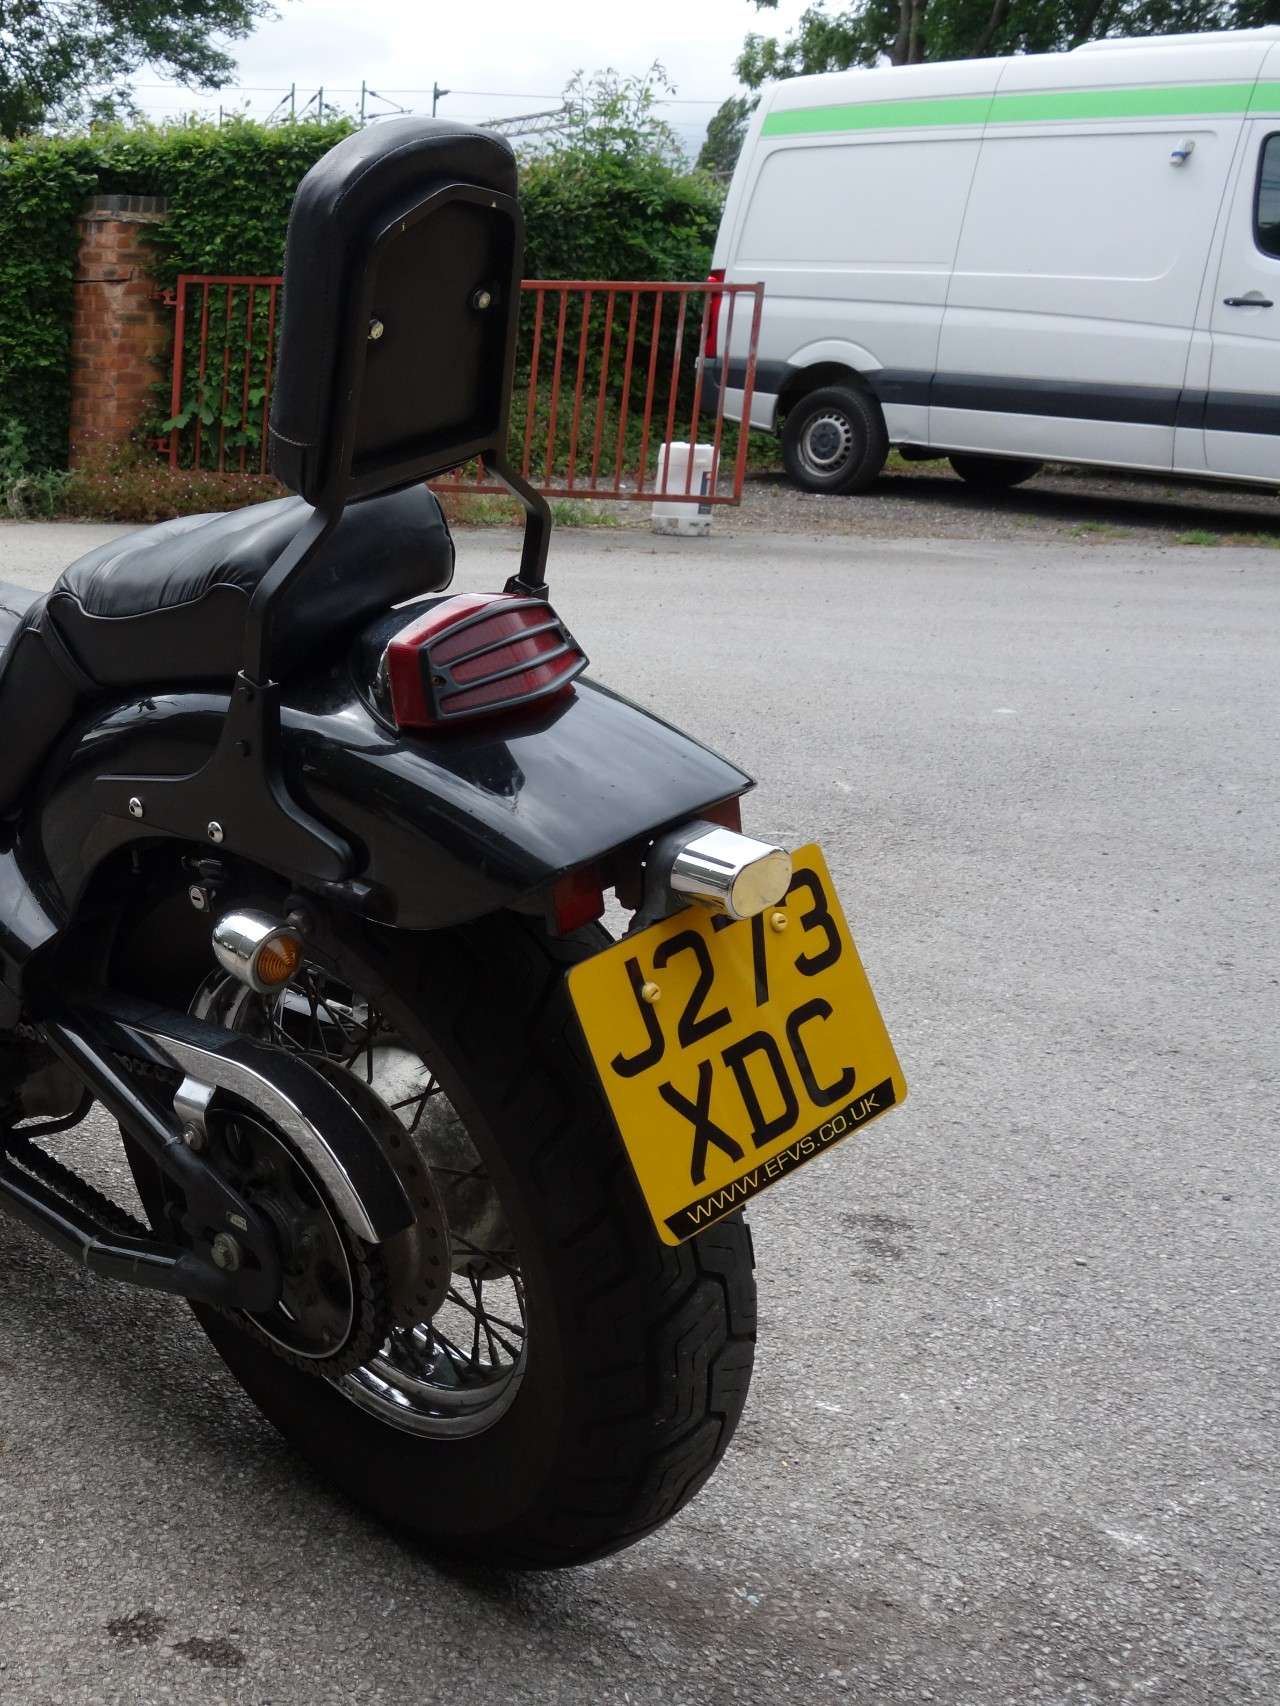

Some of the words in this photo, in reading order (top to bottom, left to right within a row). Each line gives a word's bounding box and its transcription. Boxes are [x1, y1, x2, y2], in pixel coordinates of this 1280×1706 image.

[610, 868, 842, 1078] J273
[658, 997, 856, 1186] XDC
[686, 1092, 882, 1226] WWW.EFVS.CO.UK
